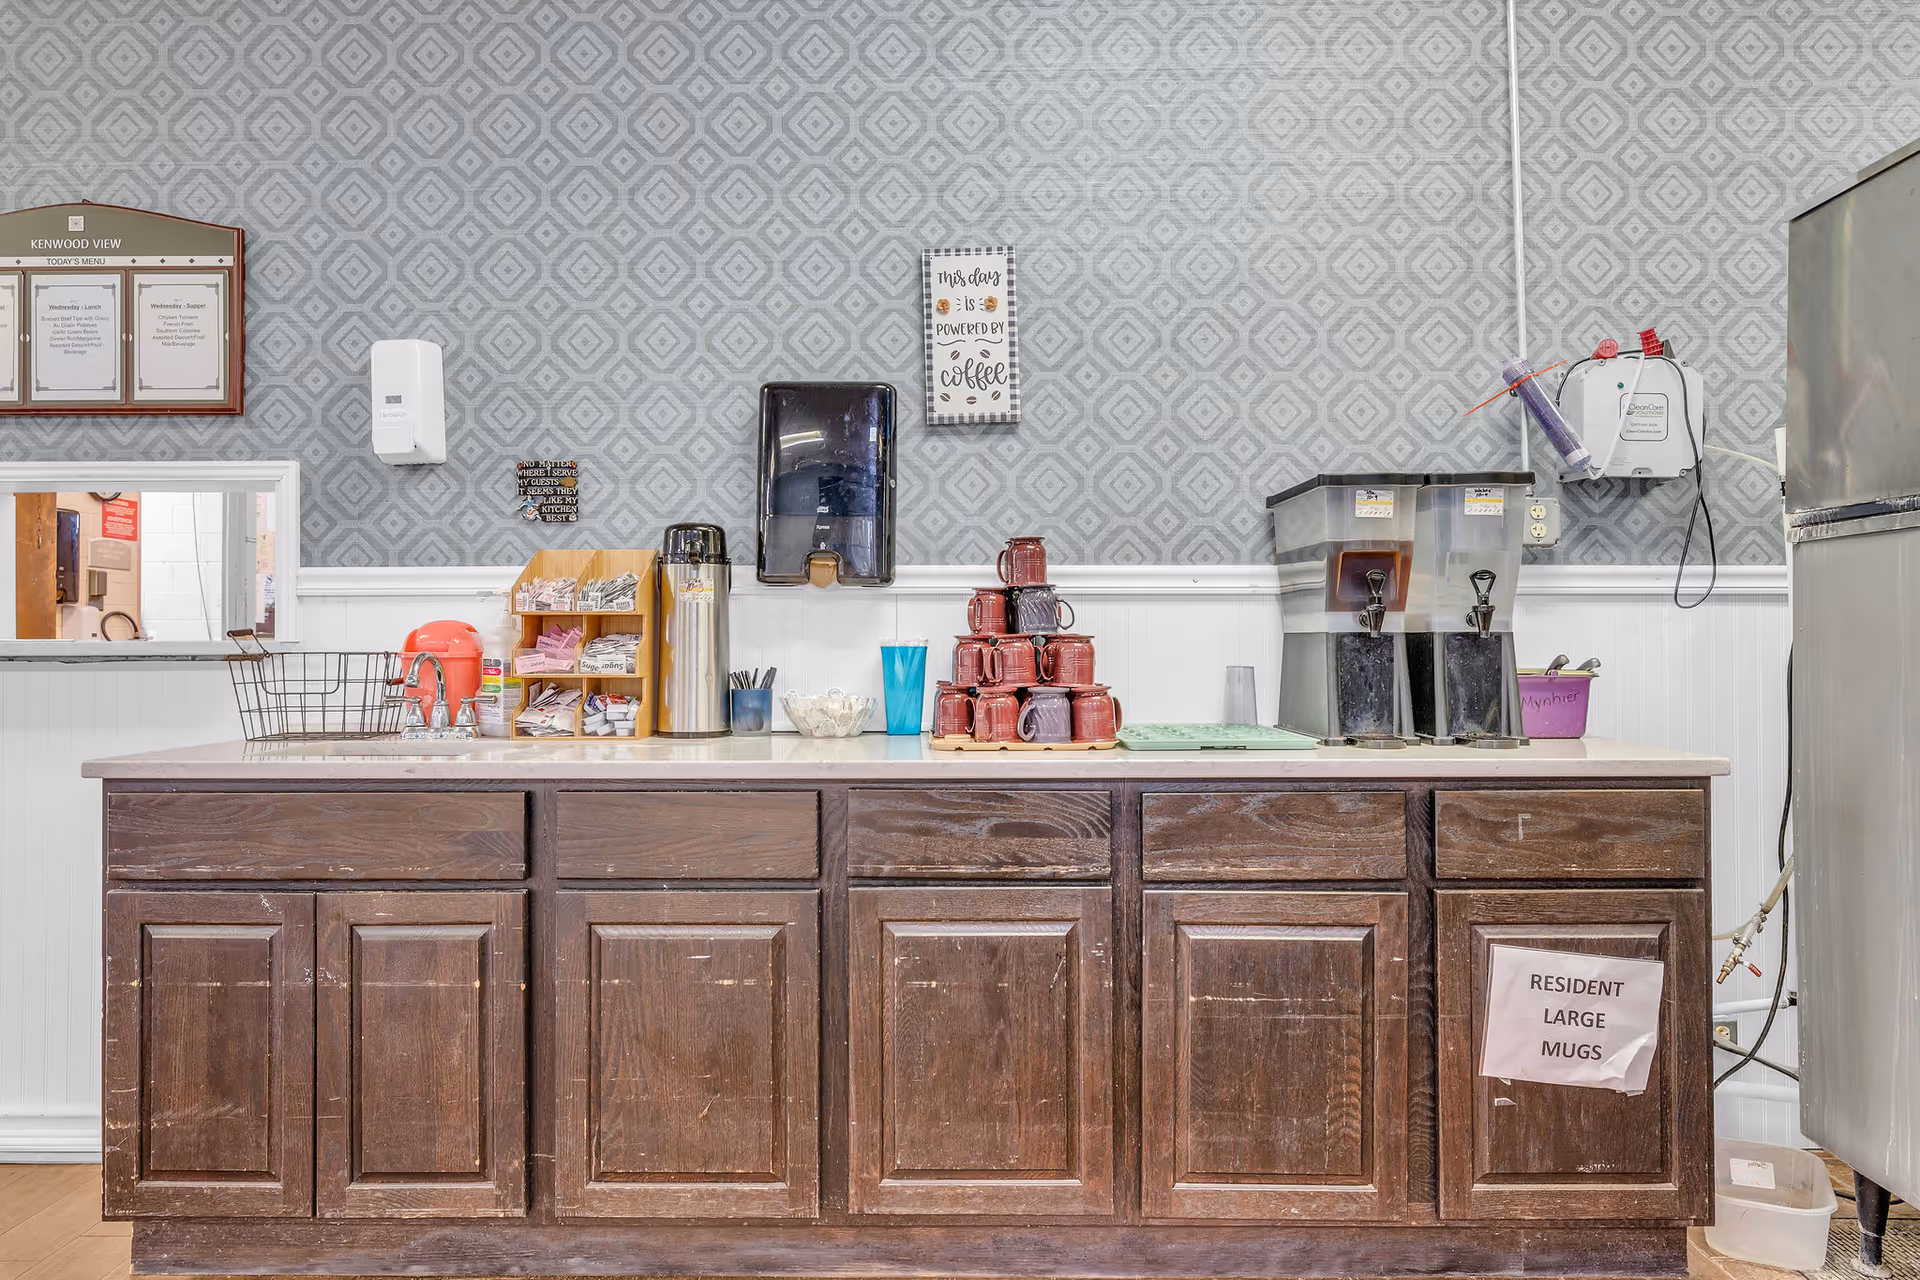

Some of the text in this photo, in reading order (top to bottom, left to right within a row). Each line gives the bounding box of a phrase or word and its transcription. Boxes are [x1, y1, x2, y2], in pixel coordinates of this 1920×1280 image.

[31, 238, 122, 249] KENWOOD VIEW
[938, 267, 1001, 288] This day
[965, 296, 976, 312] is
[936, 321, 1004, 336] POWERED BY
[941, 358, 1007, 391] coffee
[1628, 403, 1664, 411] CleanCore
[523, 460, 572, 468] NO MATTER
[517, 469, 546, 477] WHERE
[552, 469, 578, 477] SERVE
[541, 505, 577, 513] KITCHEN
[546, 514, 567, 522] BEST
[582, 661, 602, 673] Suga
[1521, 691, 1580, 713] Mynhier
[1530, 973, 1625, 997] RESIDENT
[1543, 1008, 1606, 1029] LARGE
[1541, 1040, 1602, 1061] MUGS
